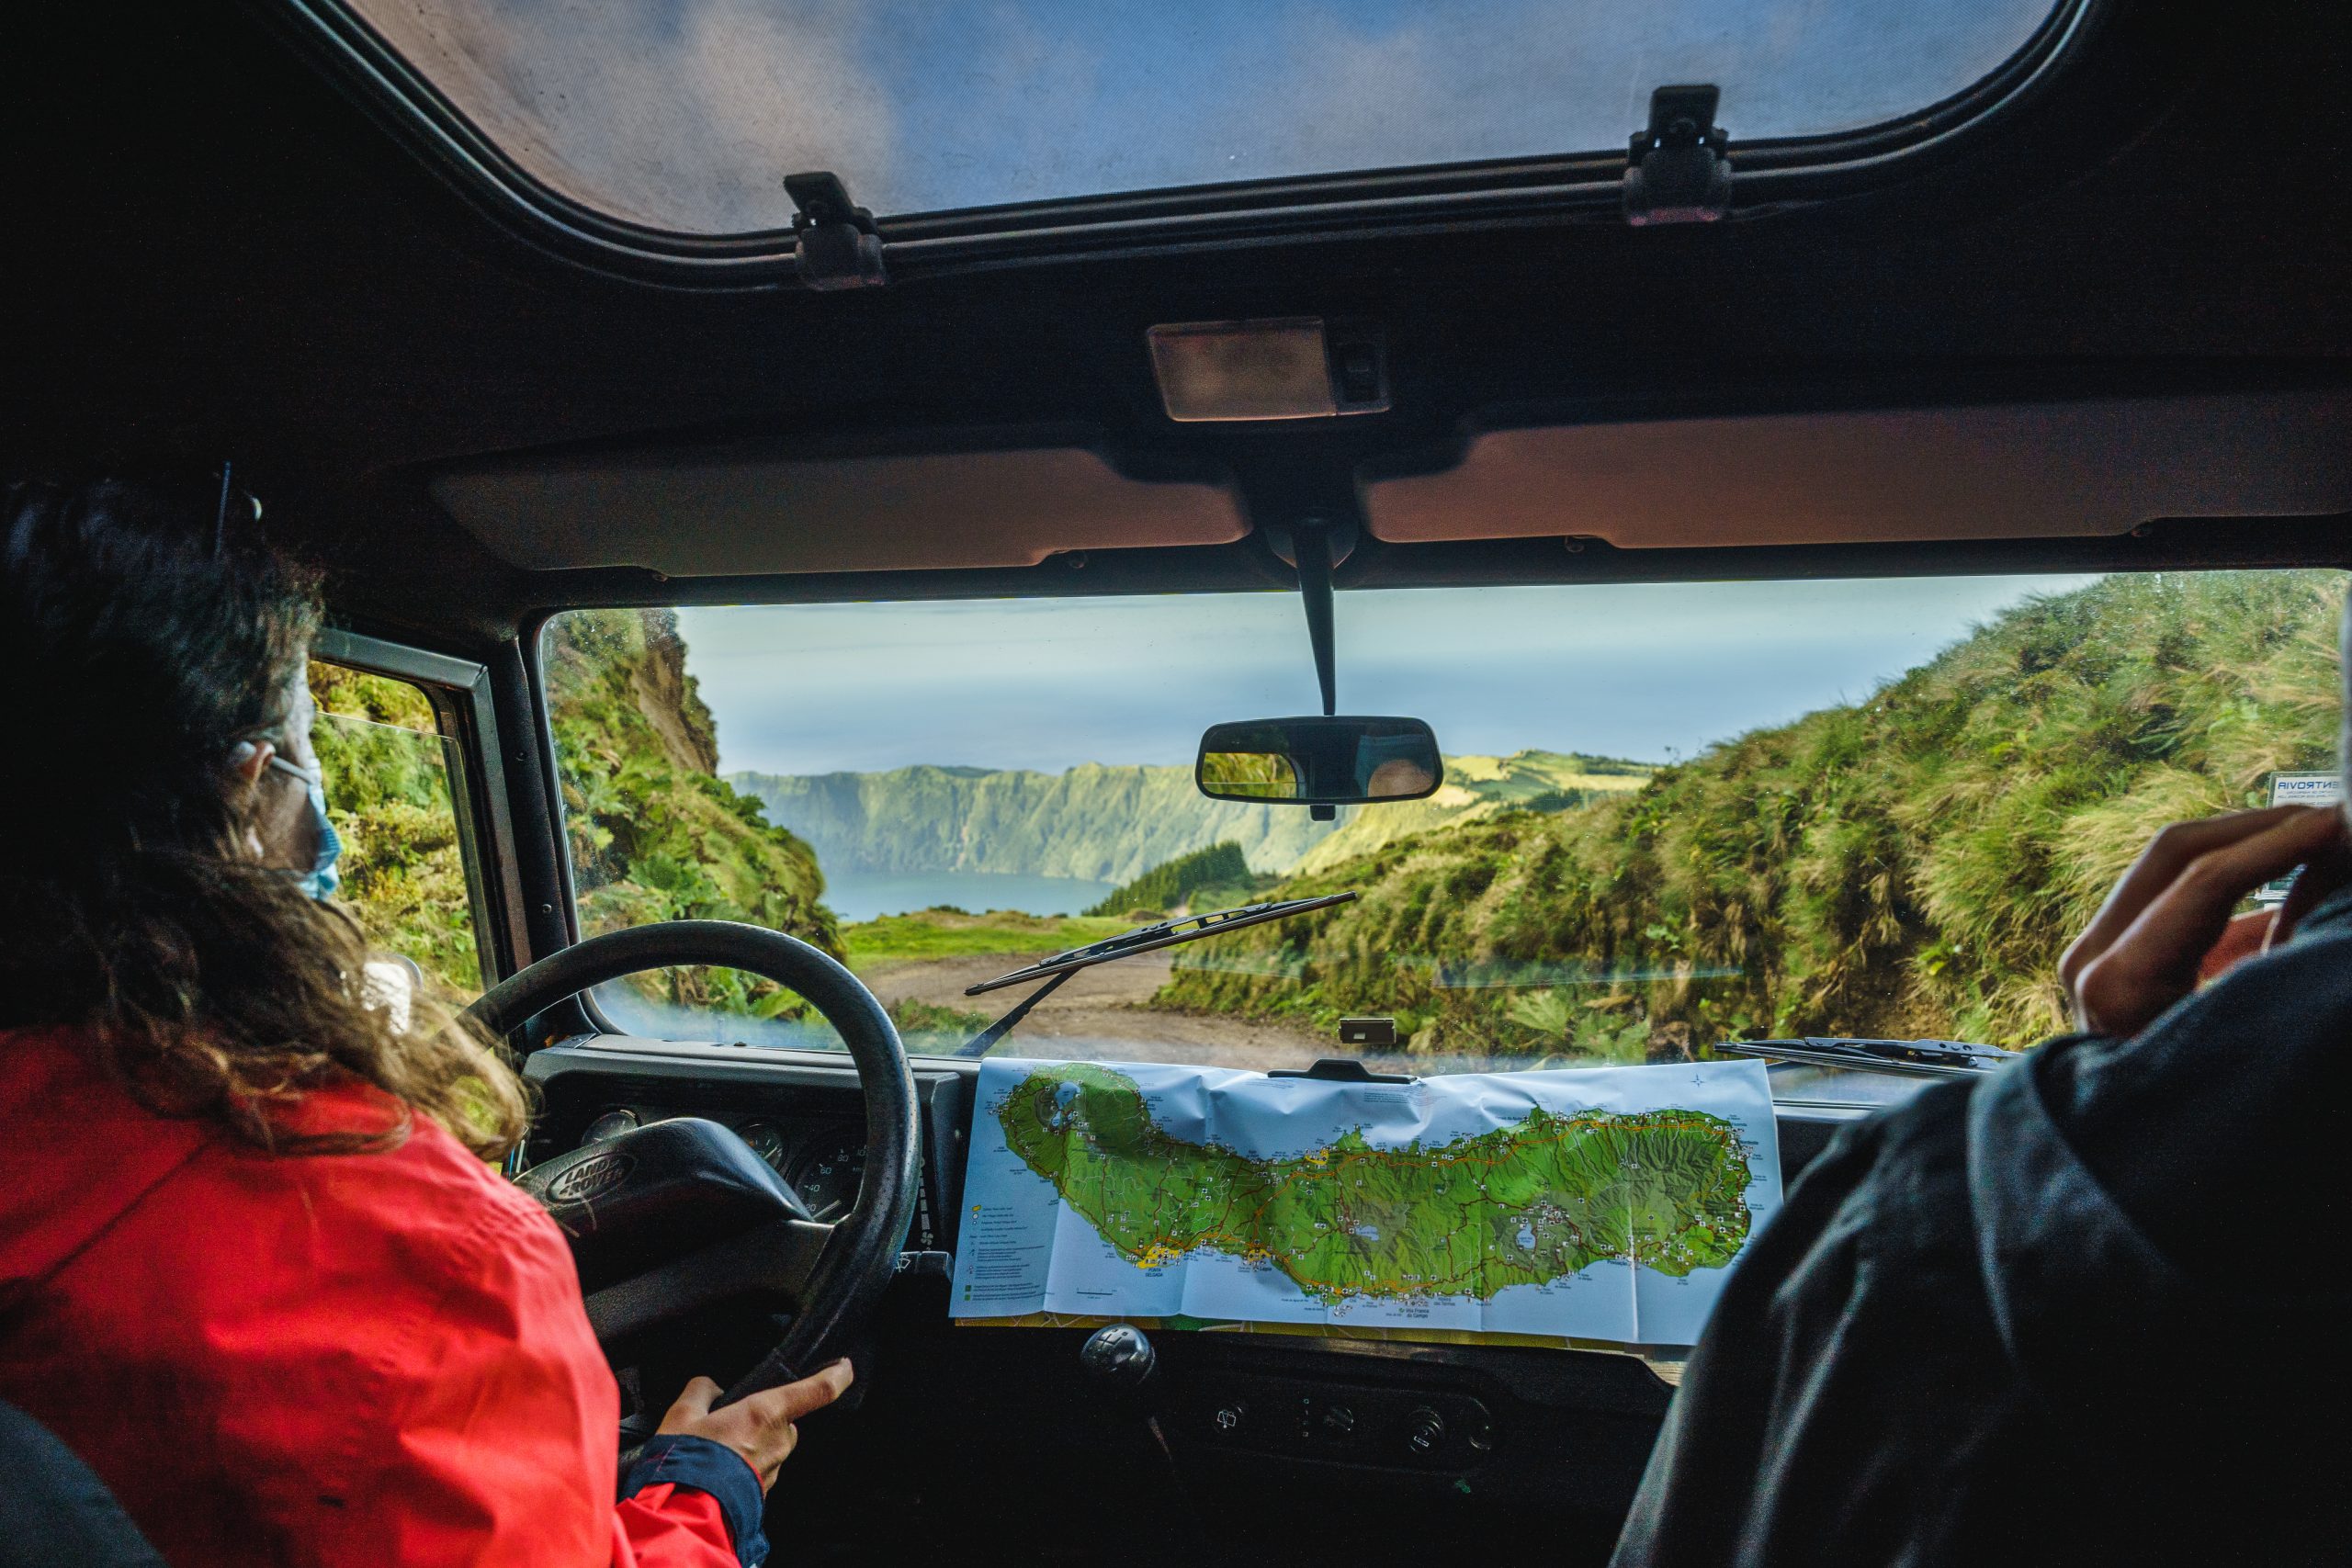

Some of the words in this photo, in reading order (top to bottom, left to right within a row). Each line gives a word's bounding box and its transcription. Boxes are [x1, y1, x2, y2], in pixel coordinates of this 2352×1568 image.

[837, 1154, 850, 1162] 80
[564, 1158, 611, 1184] LAND
[820, 1167, 832, 1175] 60
[568, 1168, 624, 1196] ROVER
[808, 1184, 820, 1192] 40
